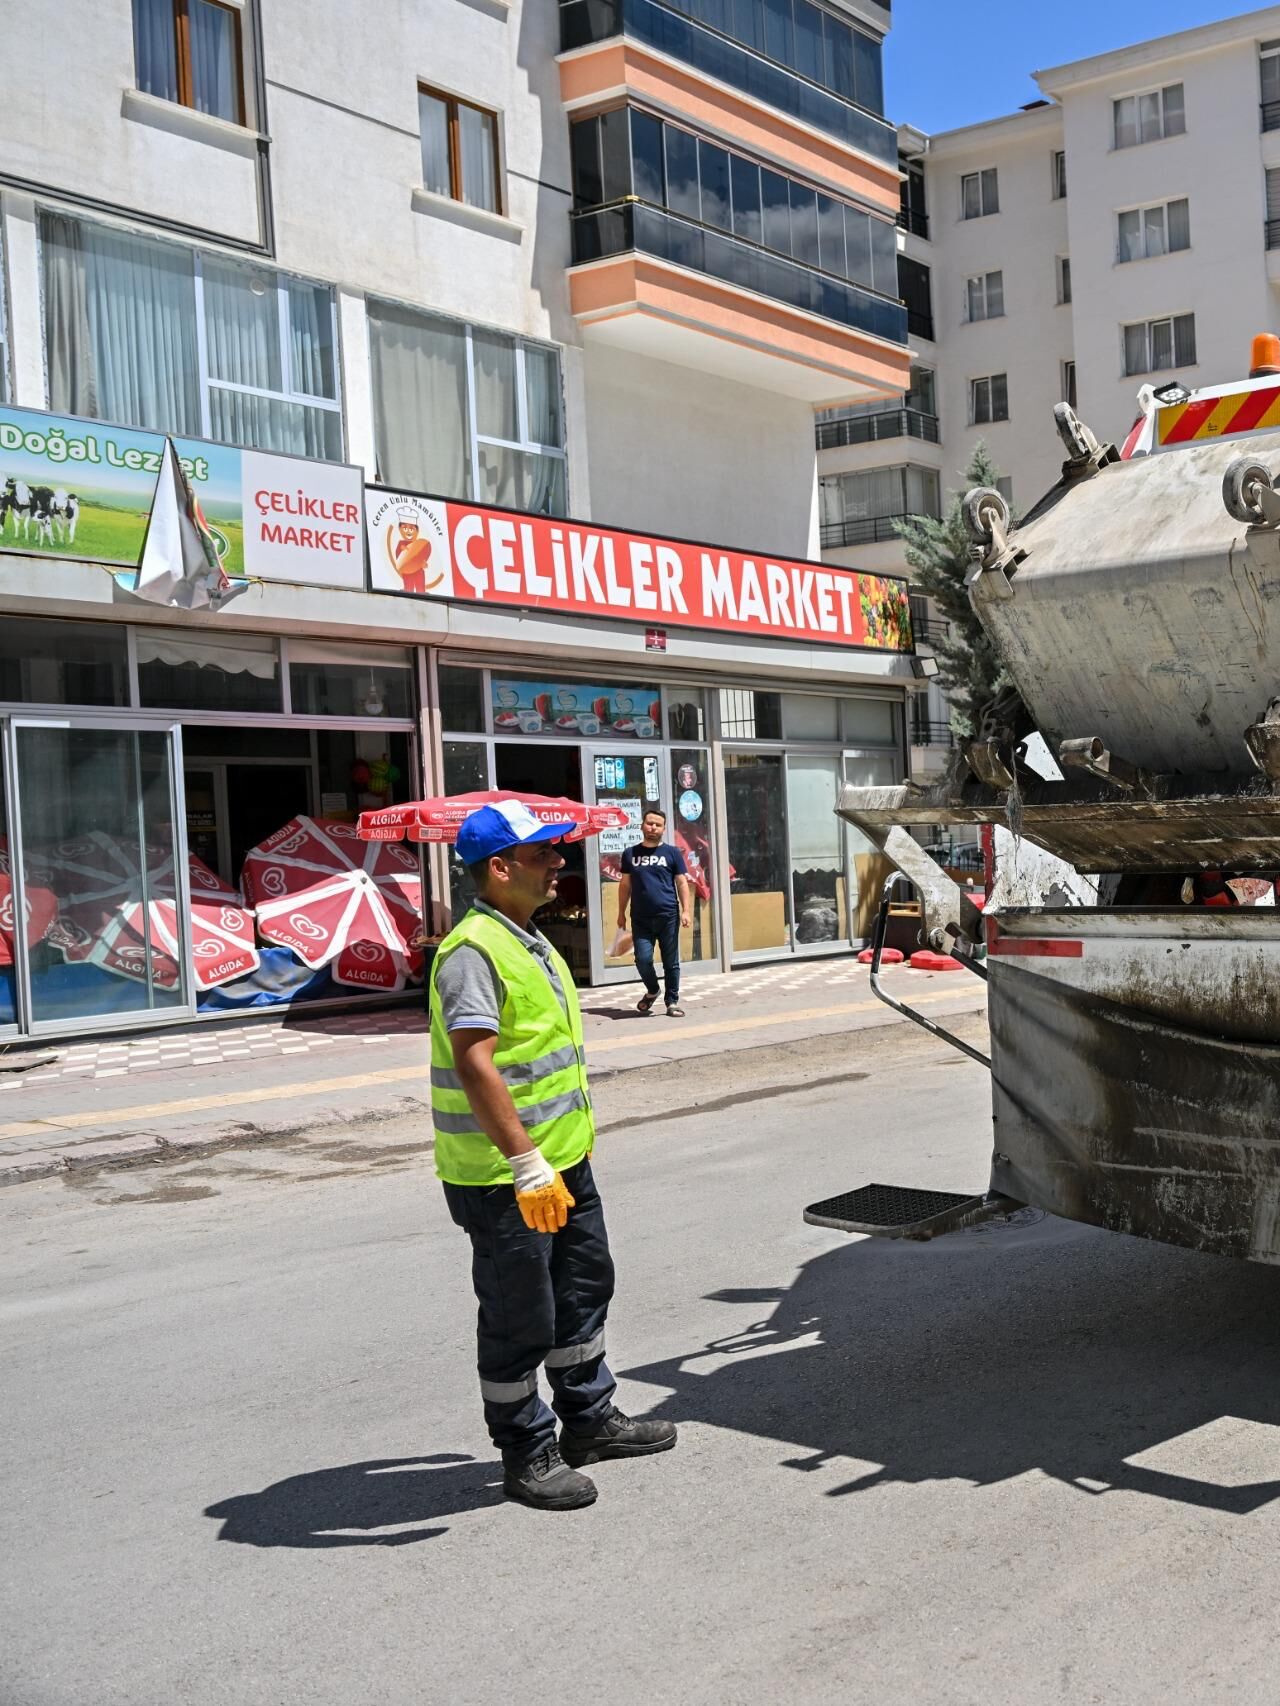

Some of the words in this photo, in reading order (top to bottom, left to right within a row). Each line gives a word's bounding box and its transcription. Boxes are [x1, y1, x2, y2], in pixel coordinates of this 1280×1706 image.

[0, 422, 102, 463] Doğal
[105, 440, 209, 481] Lezet
[254, 489, 360, 525] ÇELİKLER
[260, 522, 356, 554] MARKET
[453, 513, 690, 615] ÇELİKLER
[699, 552, 856, 636] MARKET
[534, 809, 571, 823] LGiDA
[631, 855, 668, 867] USPA
